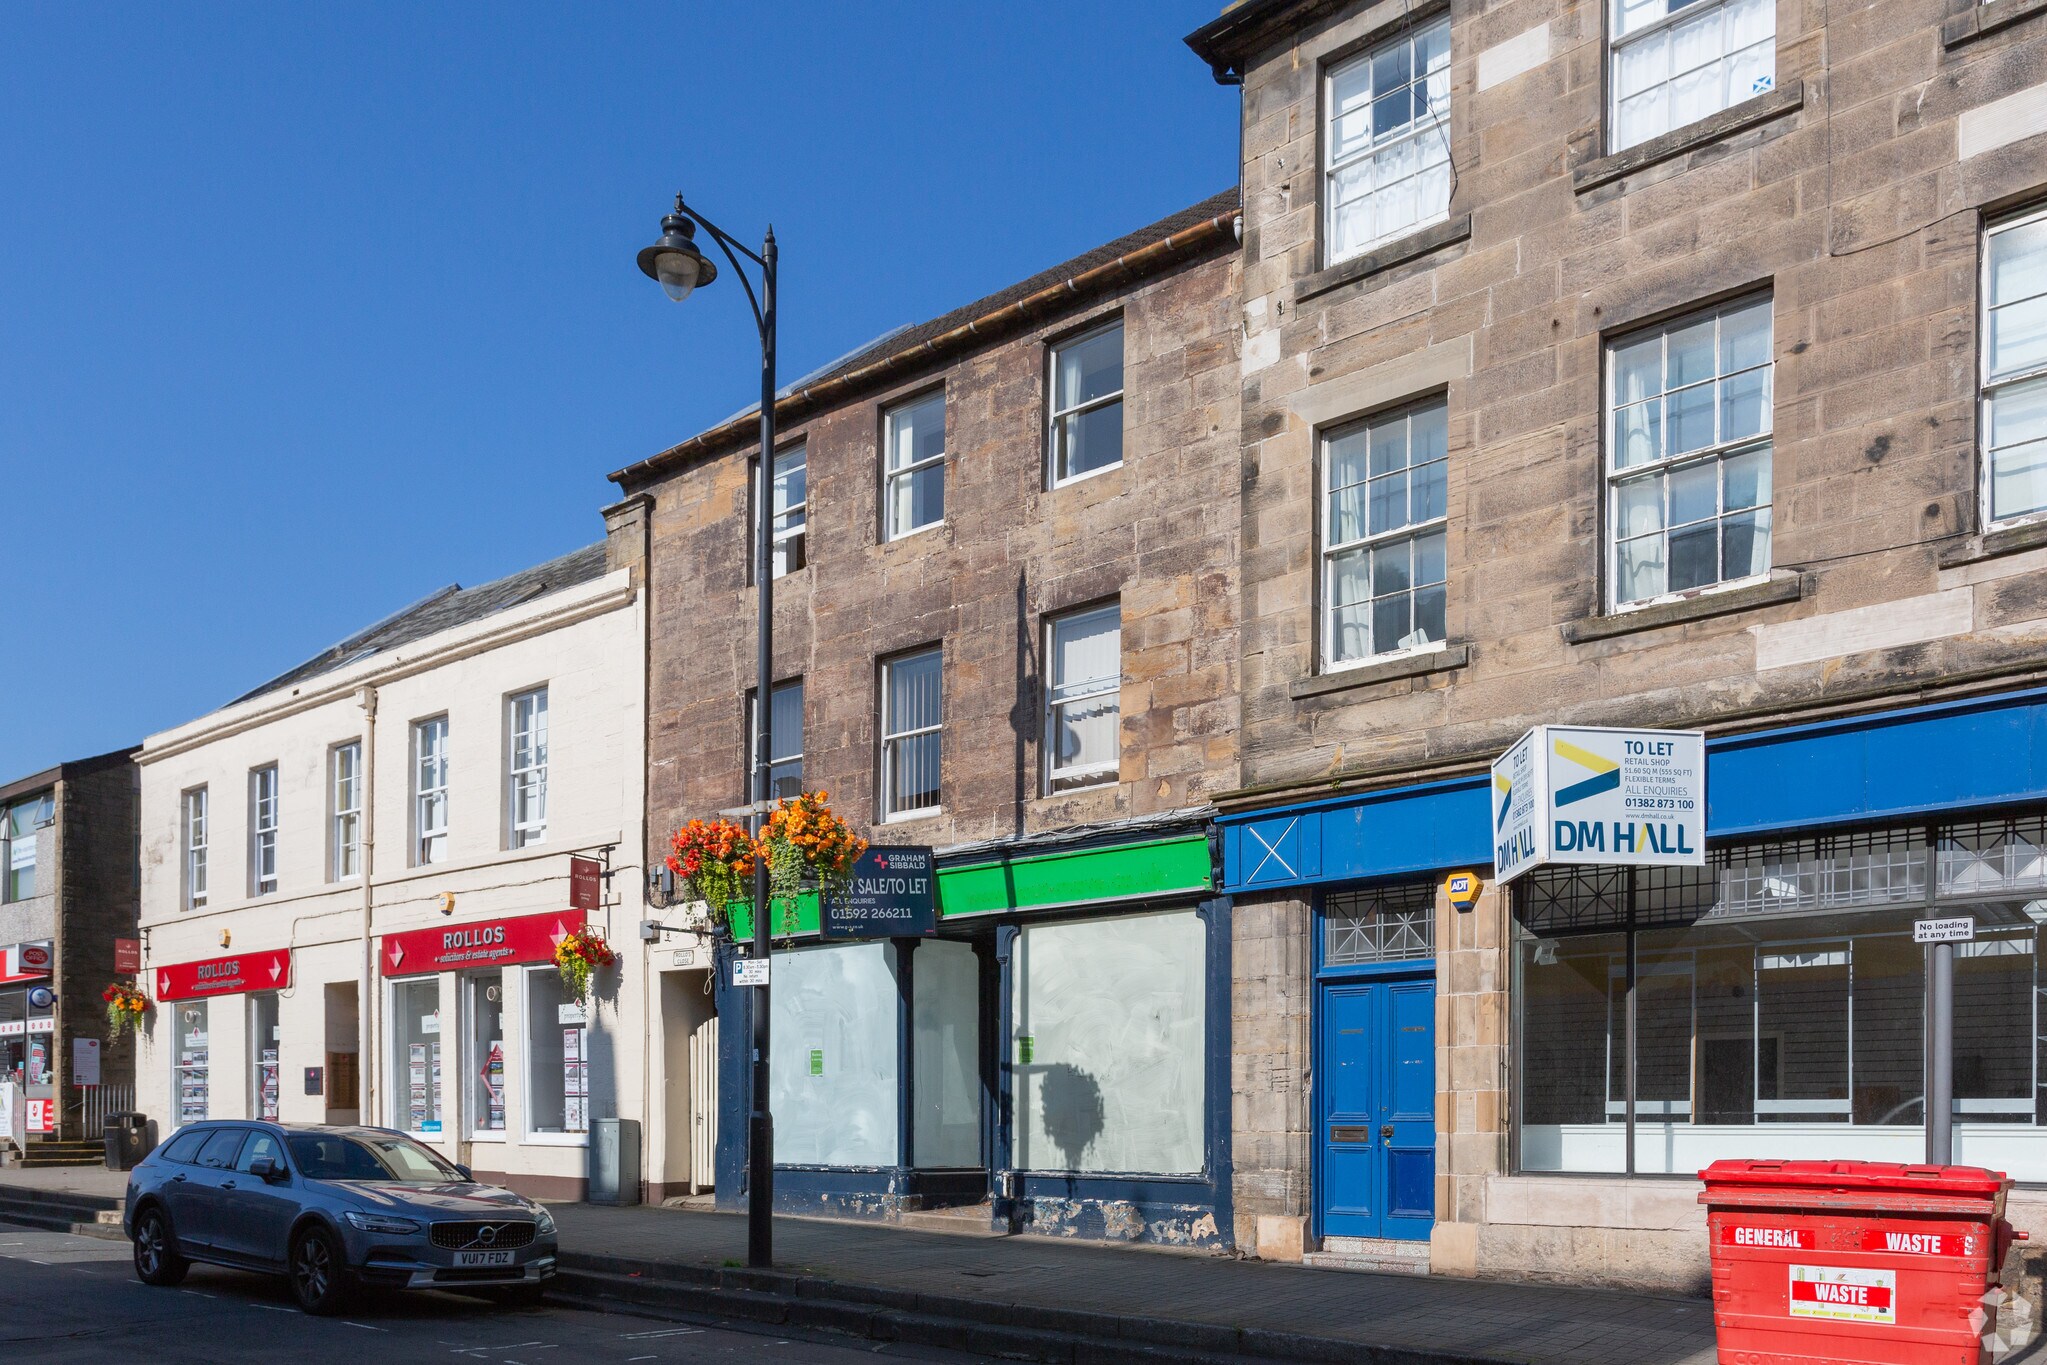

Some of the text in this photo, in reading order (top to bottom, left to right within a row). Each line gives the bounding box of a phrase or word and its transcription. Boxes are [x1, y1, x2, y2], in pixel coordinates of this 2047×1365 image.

[1624, 741, 1674, 756] TO LET
[1513, 746, 1528, 769] TO LET
[1624, 758, 1649, 766] RETAIL
[1660, 768, 1672, 776] (555
[1625, 785, 1688, 796] ALL ENQUIRIES
[1625, 798, 1694, 809] 01382 873 100
[1625, 812, 1674, 820] www.dmhall.co.uk
[1554, 820, 1694, 854] DM HALL
[1498, 825, 1535, 874] DM HALL
[888, 854, 925, 862] GRAHAM
[574, 874, 597, 882] ROLLOS
[858, 878, 906, 894] SALE/TO
[909, 878, 928, 894] LET
[1452, 880, 1468, 890] ADT
[831, 908, 912, 919] 01592 266211
[1935, 922, 1968, 930] loading
[443, 926, 505, 949] ROLLOS
[198, 960, 240, 980] ROLLOS
[736, 963, 741, 973] P
[1735, 1228, 1802, 1247] GENERAL
[1886, 1233, 1941, 1253] WASTE
[461, 1252, 509, 1264] VU17 FDZ
[1815, 1283, 1867, 1304] WASTE
